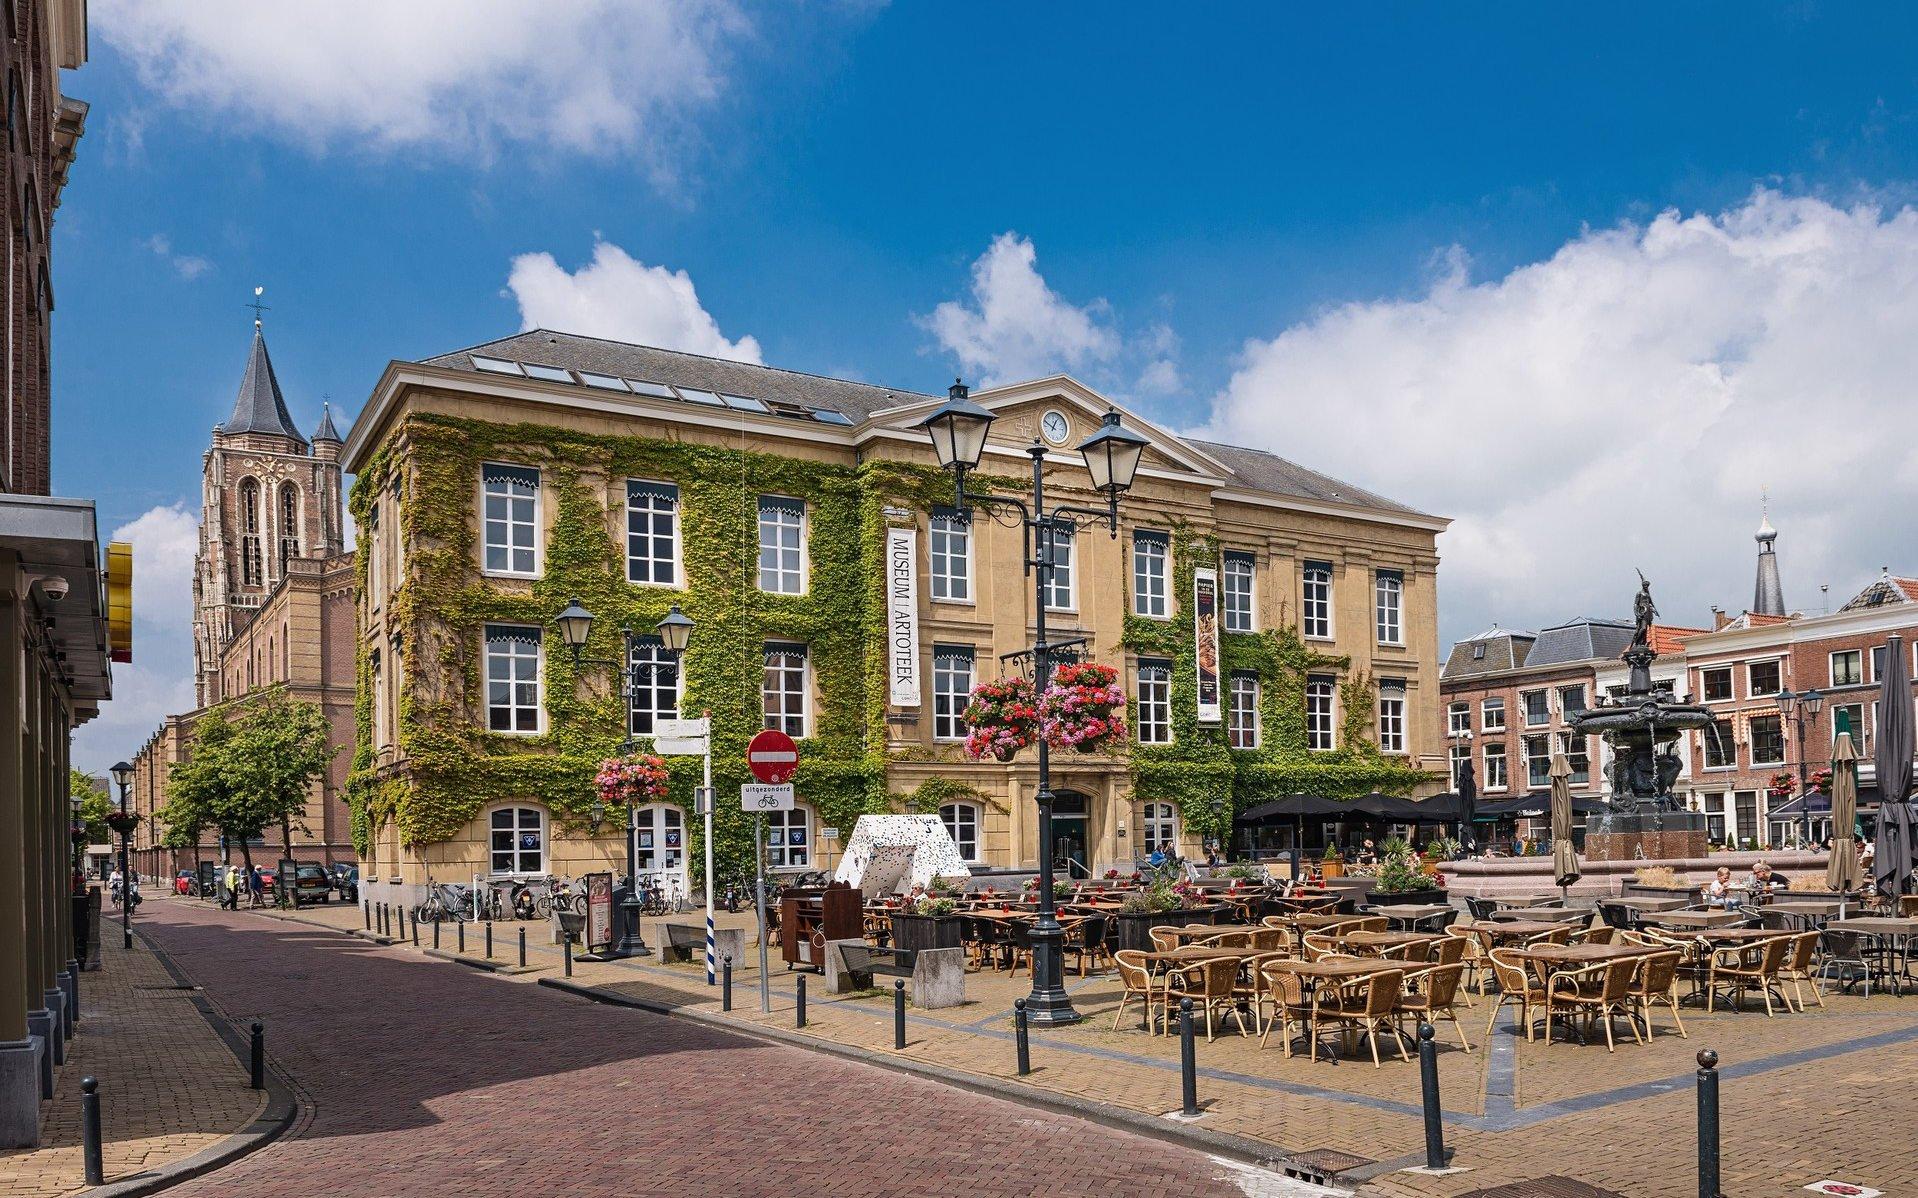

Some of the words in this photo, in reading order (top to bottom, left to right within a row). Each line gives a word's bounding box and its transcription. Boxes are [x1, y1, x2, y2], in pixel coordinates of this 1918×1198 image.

[893, 538, 910, 599] MUSEUM
[895, 610, 913, 685] ARTOTEEK
[745, 786, 791, 794] uitgezonderd
